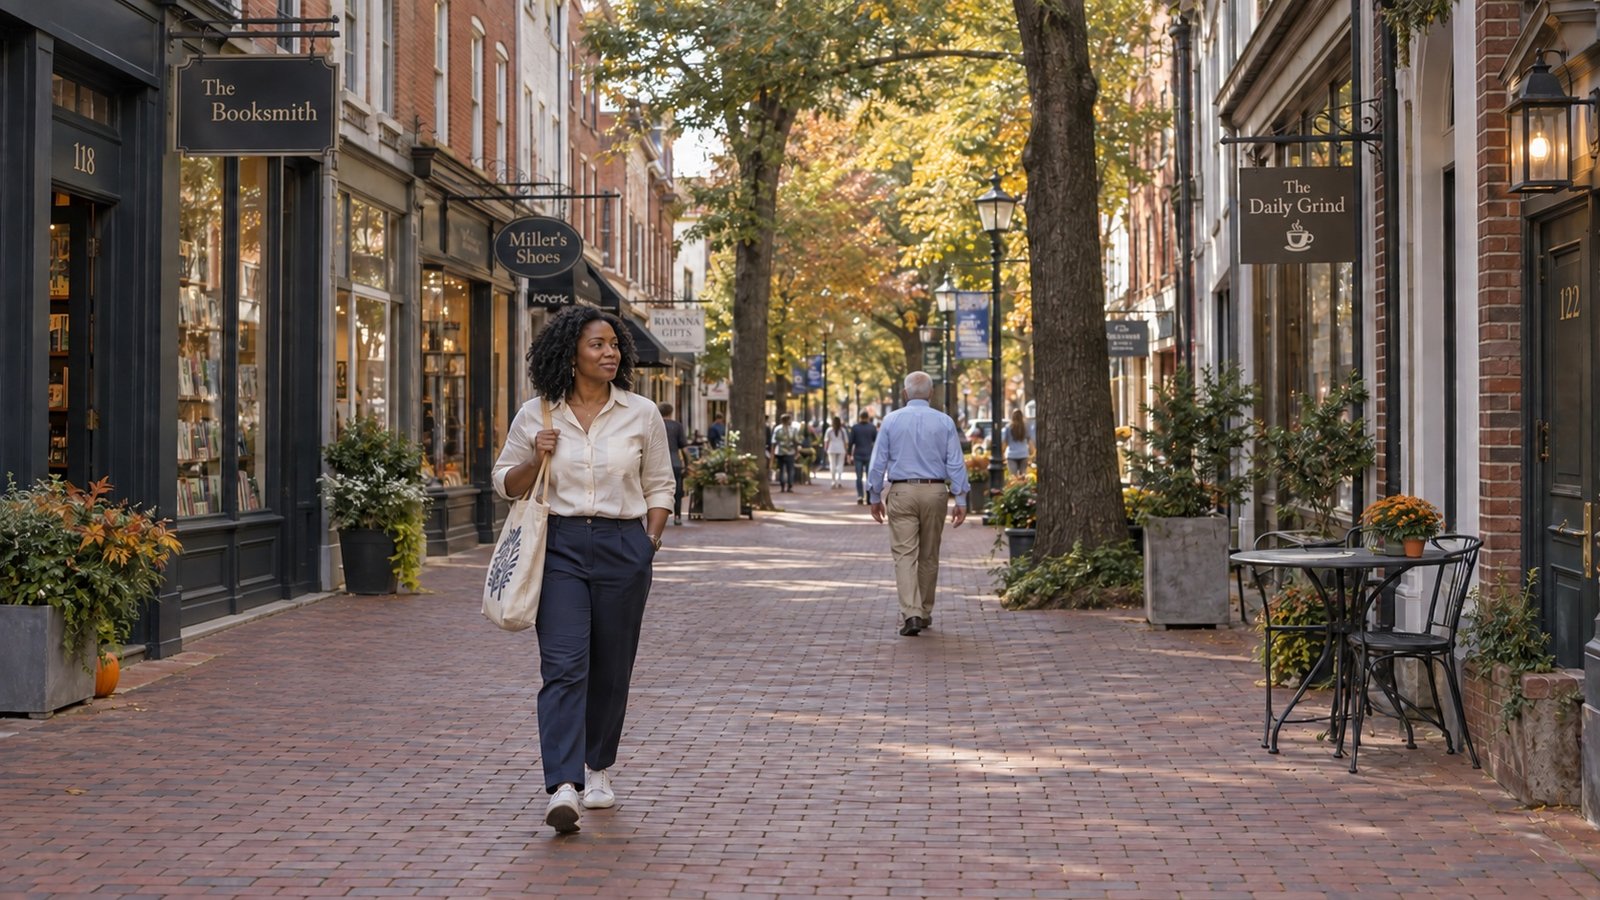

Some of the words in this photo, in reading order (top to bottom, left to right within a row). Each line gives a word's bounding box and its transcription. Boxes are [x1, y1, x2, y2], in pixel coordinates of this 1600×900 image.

[201, 79, 235, 97] The
[211, 101, 318, 122] Booksmith
[73, 142, 95, 175] 118
[1283, 179, 1311, 194] The
[1249, 197, 1292, 218] Daily
[1297, 196, 1345, 213] Grind
[509, 231, 568, 247] Miller's
[516, 249, 561, 264] Shoes
[1559, 285, 1580, 321] 122
[654, 317, 701, 326] RIVANNA
[661, 328, 692, 337] GIFTS
